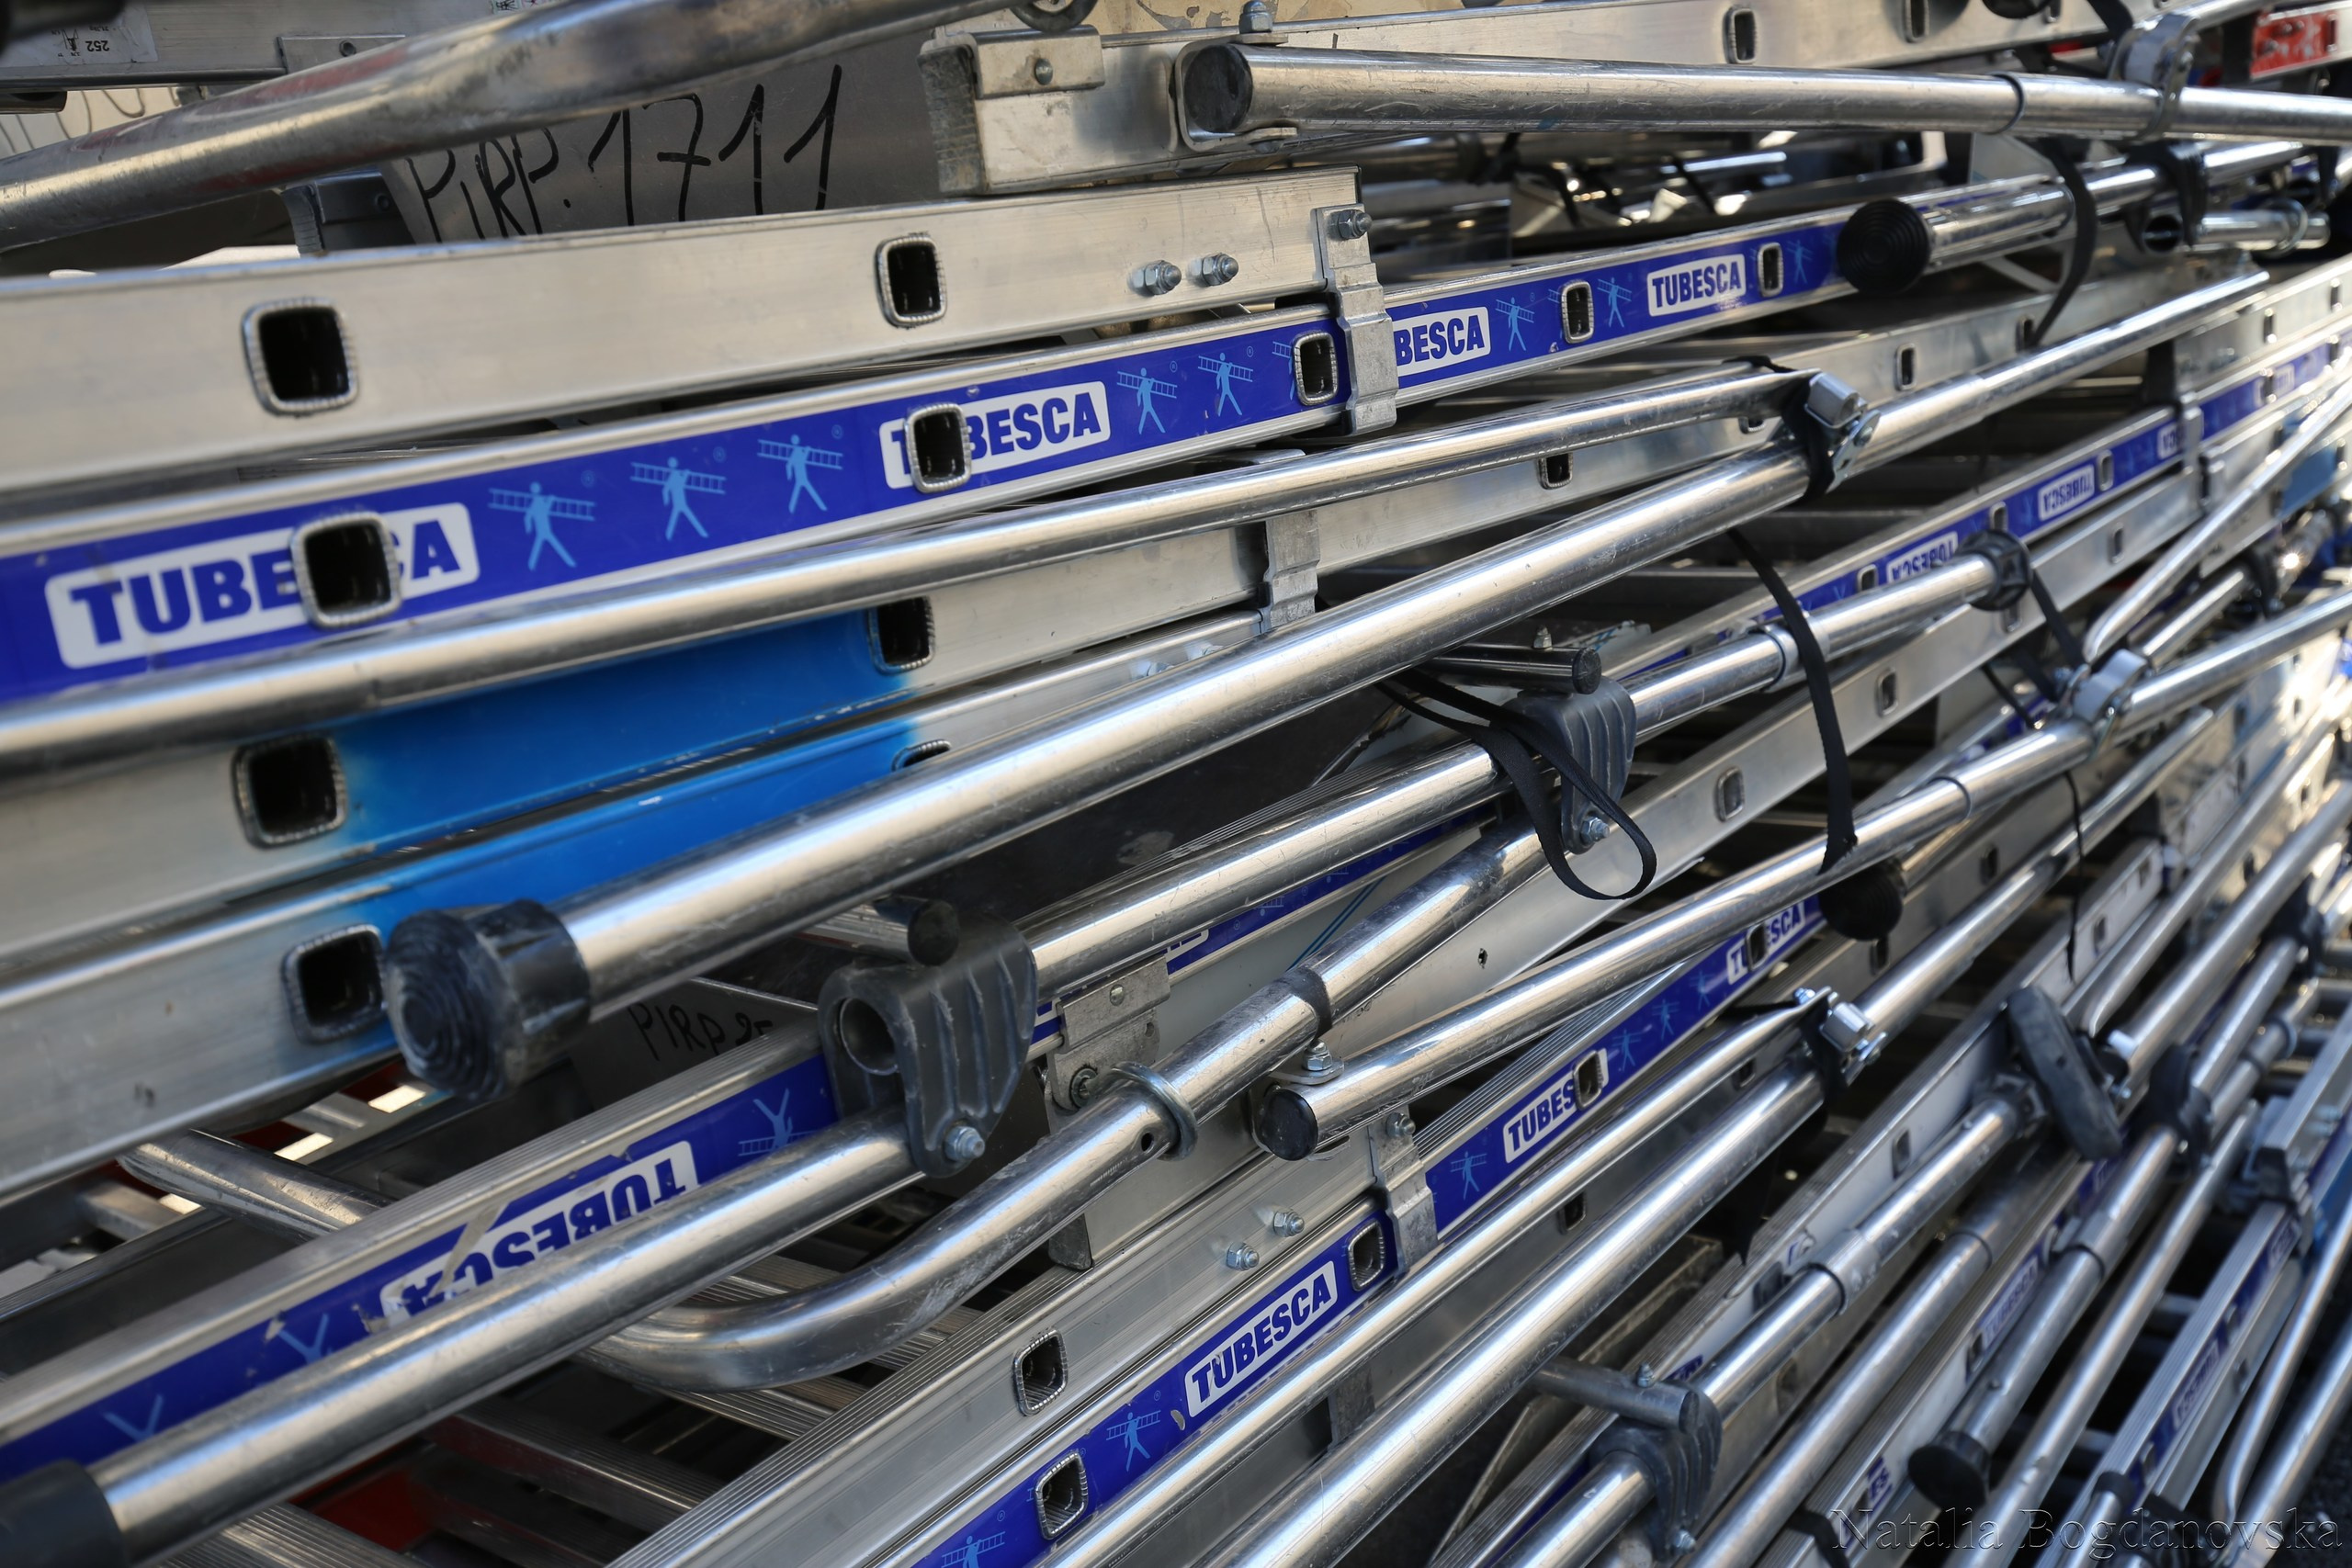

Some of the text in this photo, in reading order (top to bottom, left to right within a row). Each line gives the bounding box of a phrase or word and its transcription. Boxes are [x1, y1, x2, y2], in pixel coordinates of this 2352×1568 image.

[85, 40, 109, 52] 252
[589, 64, 842, 226] 1711
[1652, 261, 1742, 308] TUBESCA
[2042, 473, 2094, 513] TUBESCA
[70, 519, 461, 645] TUBEA
[1192, 1273, 1331, 1404] TUBESCA
